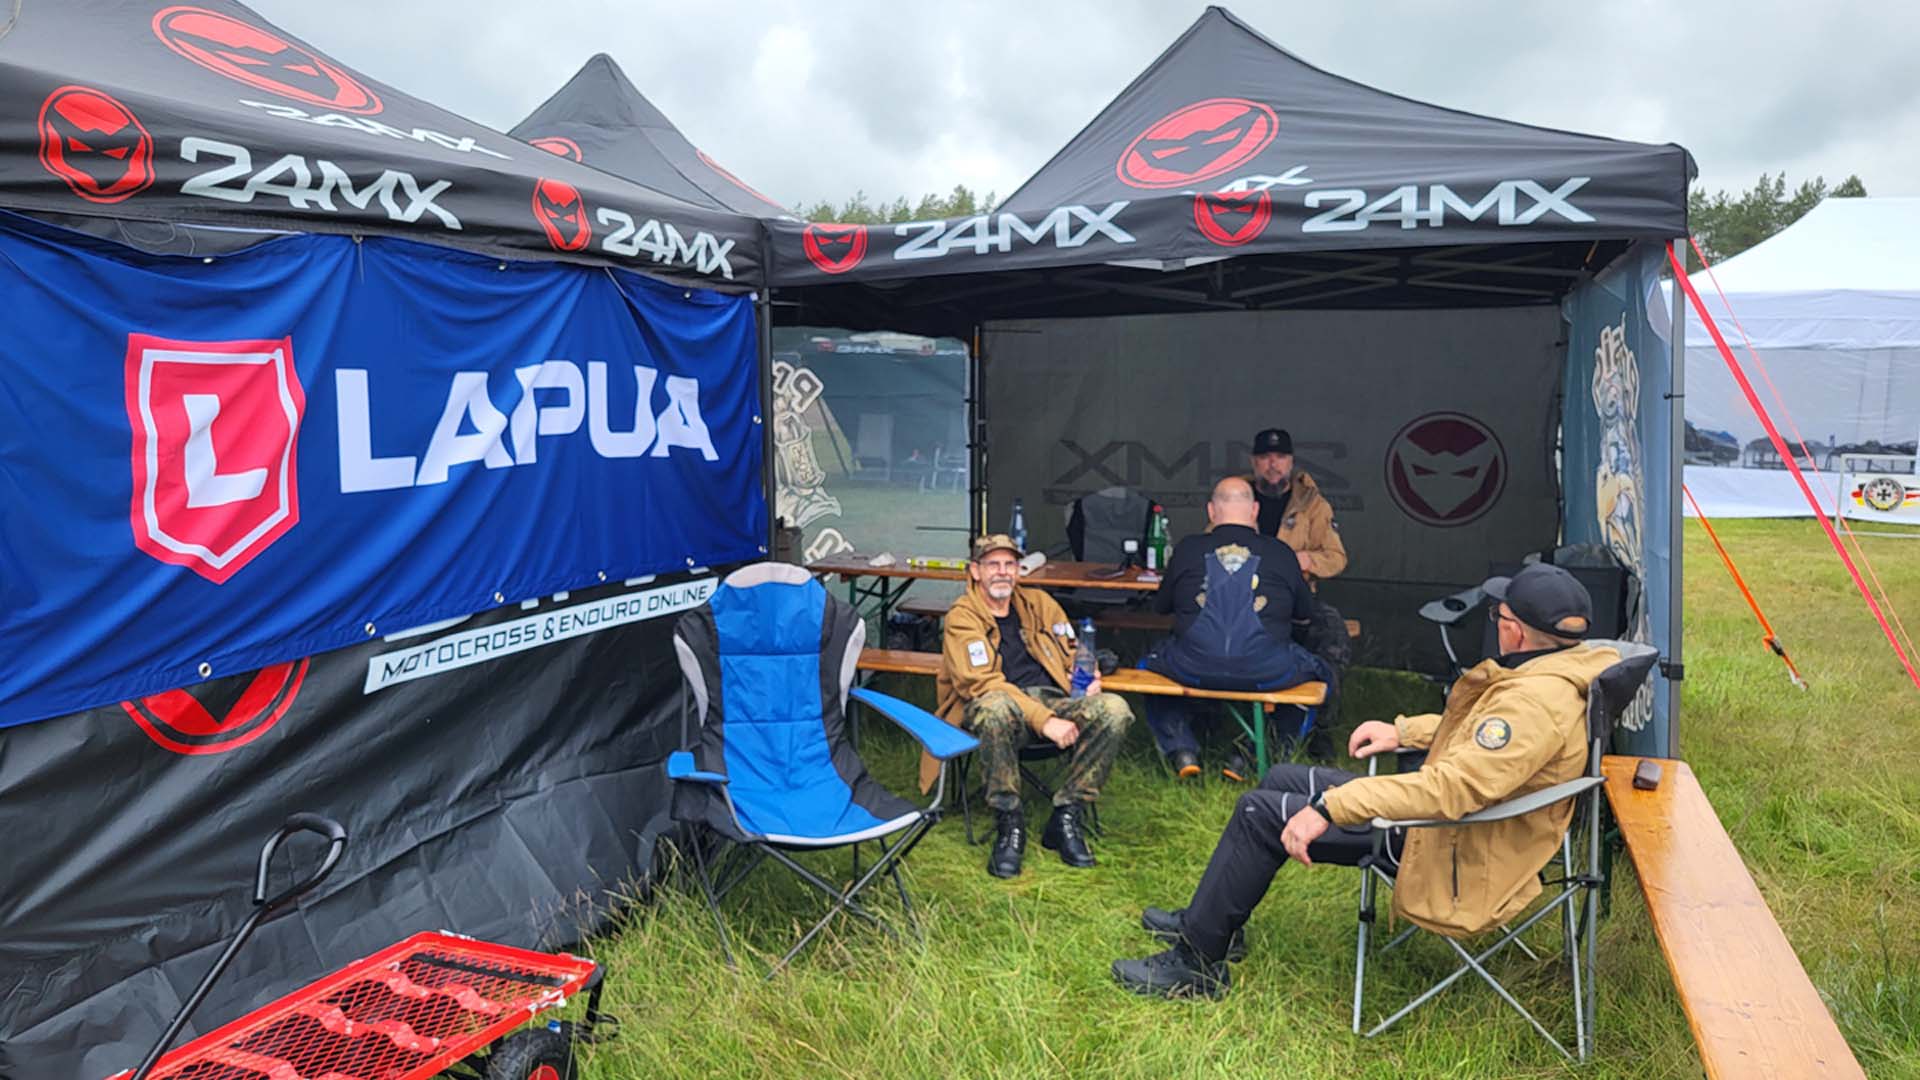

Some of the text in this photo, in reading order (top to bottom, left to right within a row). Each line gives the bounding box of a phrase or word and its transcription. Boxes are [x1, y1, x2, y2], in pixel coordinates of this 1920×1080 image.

[239, 99, 512, 160] 24MX
[180, 137, 462, 230] 24MX
[1301, 177, 1596, 232] 24MX
[598, 208, 735, 279] 24MX
[893, 201, 1136, 260] 24MX
[182, 394, 268, 509] L
[335, 360, 719, 494] LAPUA
[381, 626, 537, 683] MOTOCROSS
[542, 617, 556, 641] &
[558, 602, 641, 634] ENDURO
[647, 584, 708, 611] ONLINE
